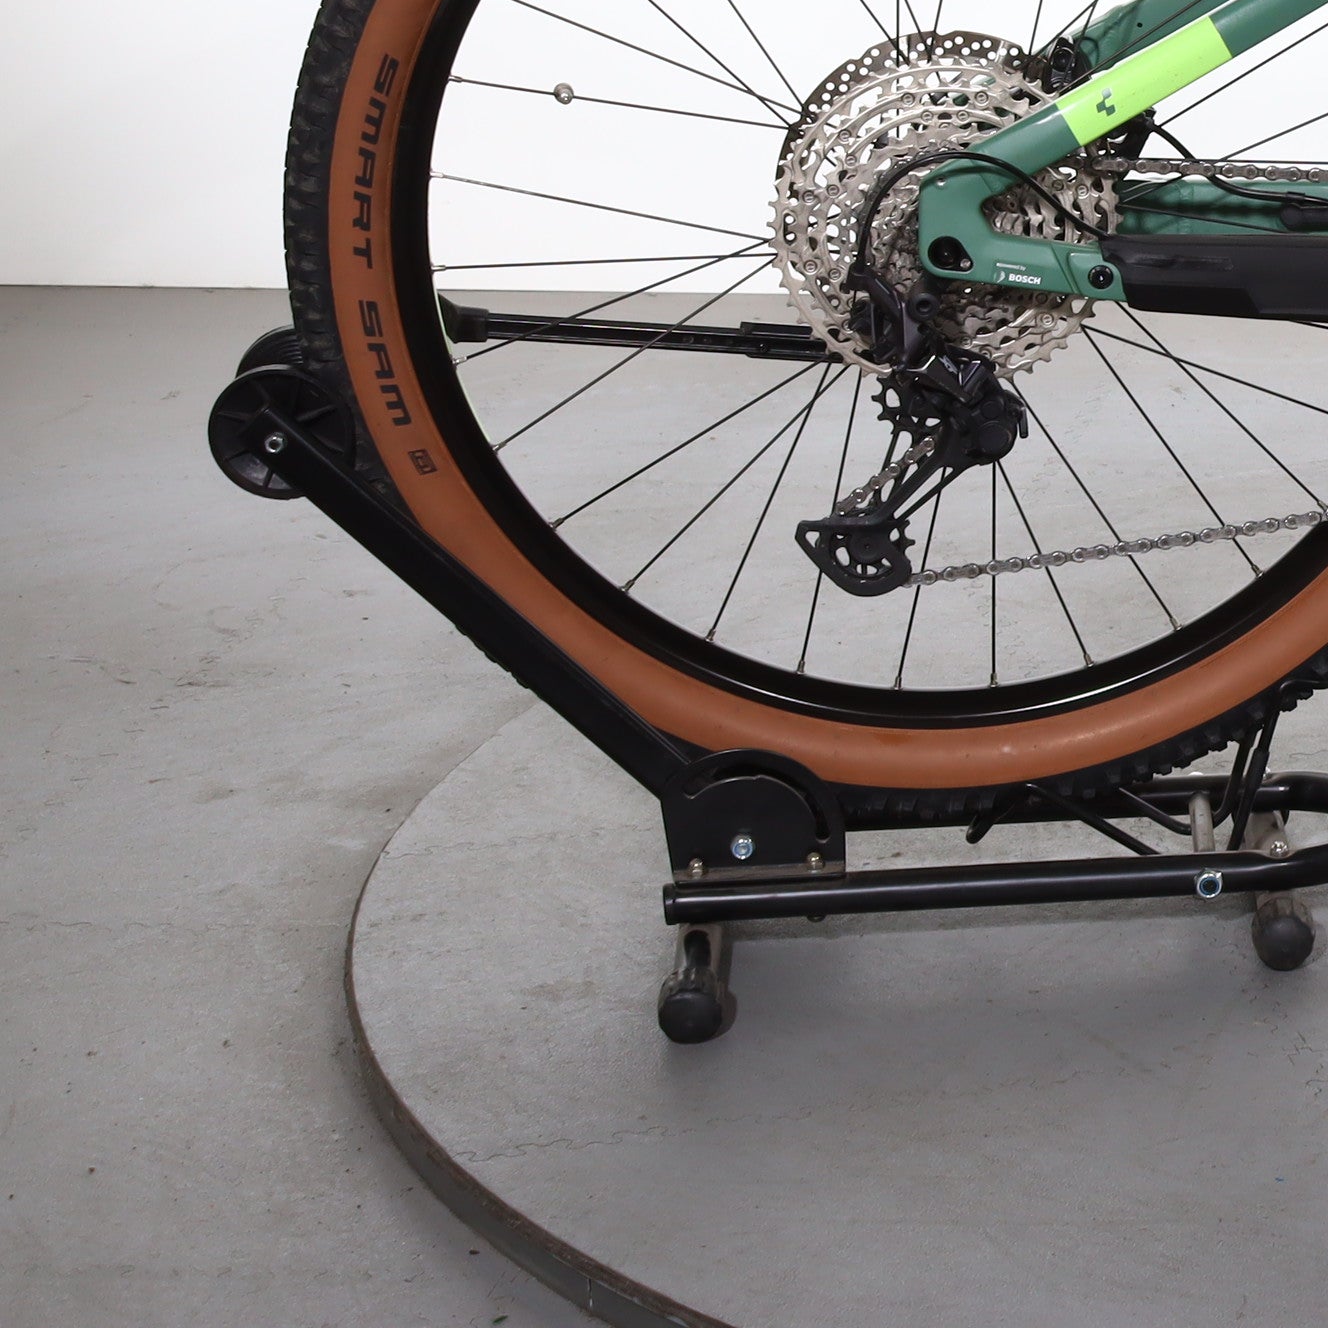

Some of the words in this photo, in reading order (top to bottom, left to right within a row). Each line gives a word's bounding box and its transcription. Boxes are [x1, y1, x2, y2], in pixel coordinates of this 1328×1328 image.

[352, 54, 400, 269] SMART
[1008, 273, 1042, 285] BOSCH
[358, 299, 410, 427] SAM
